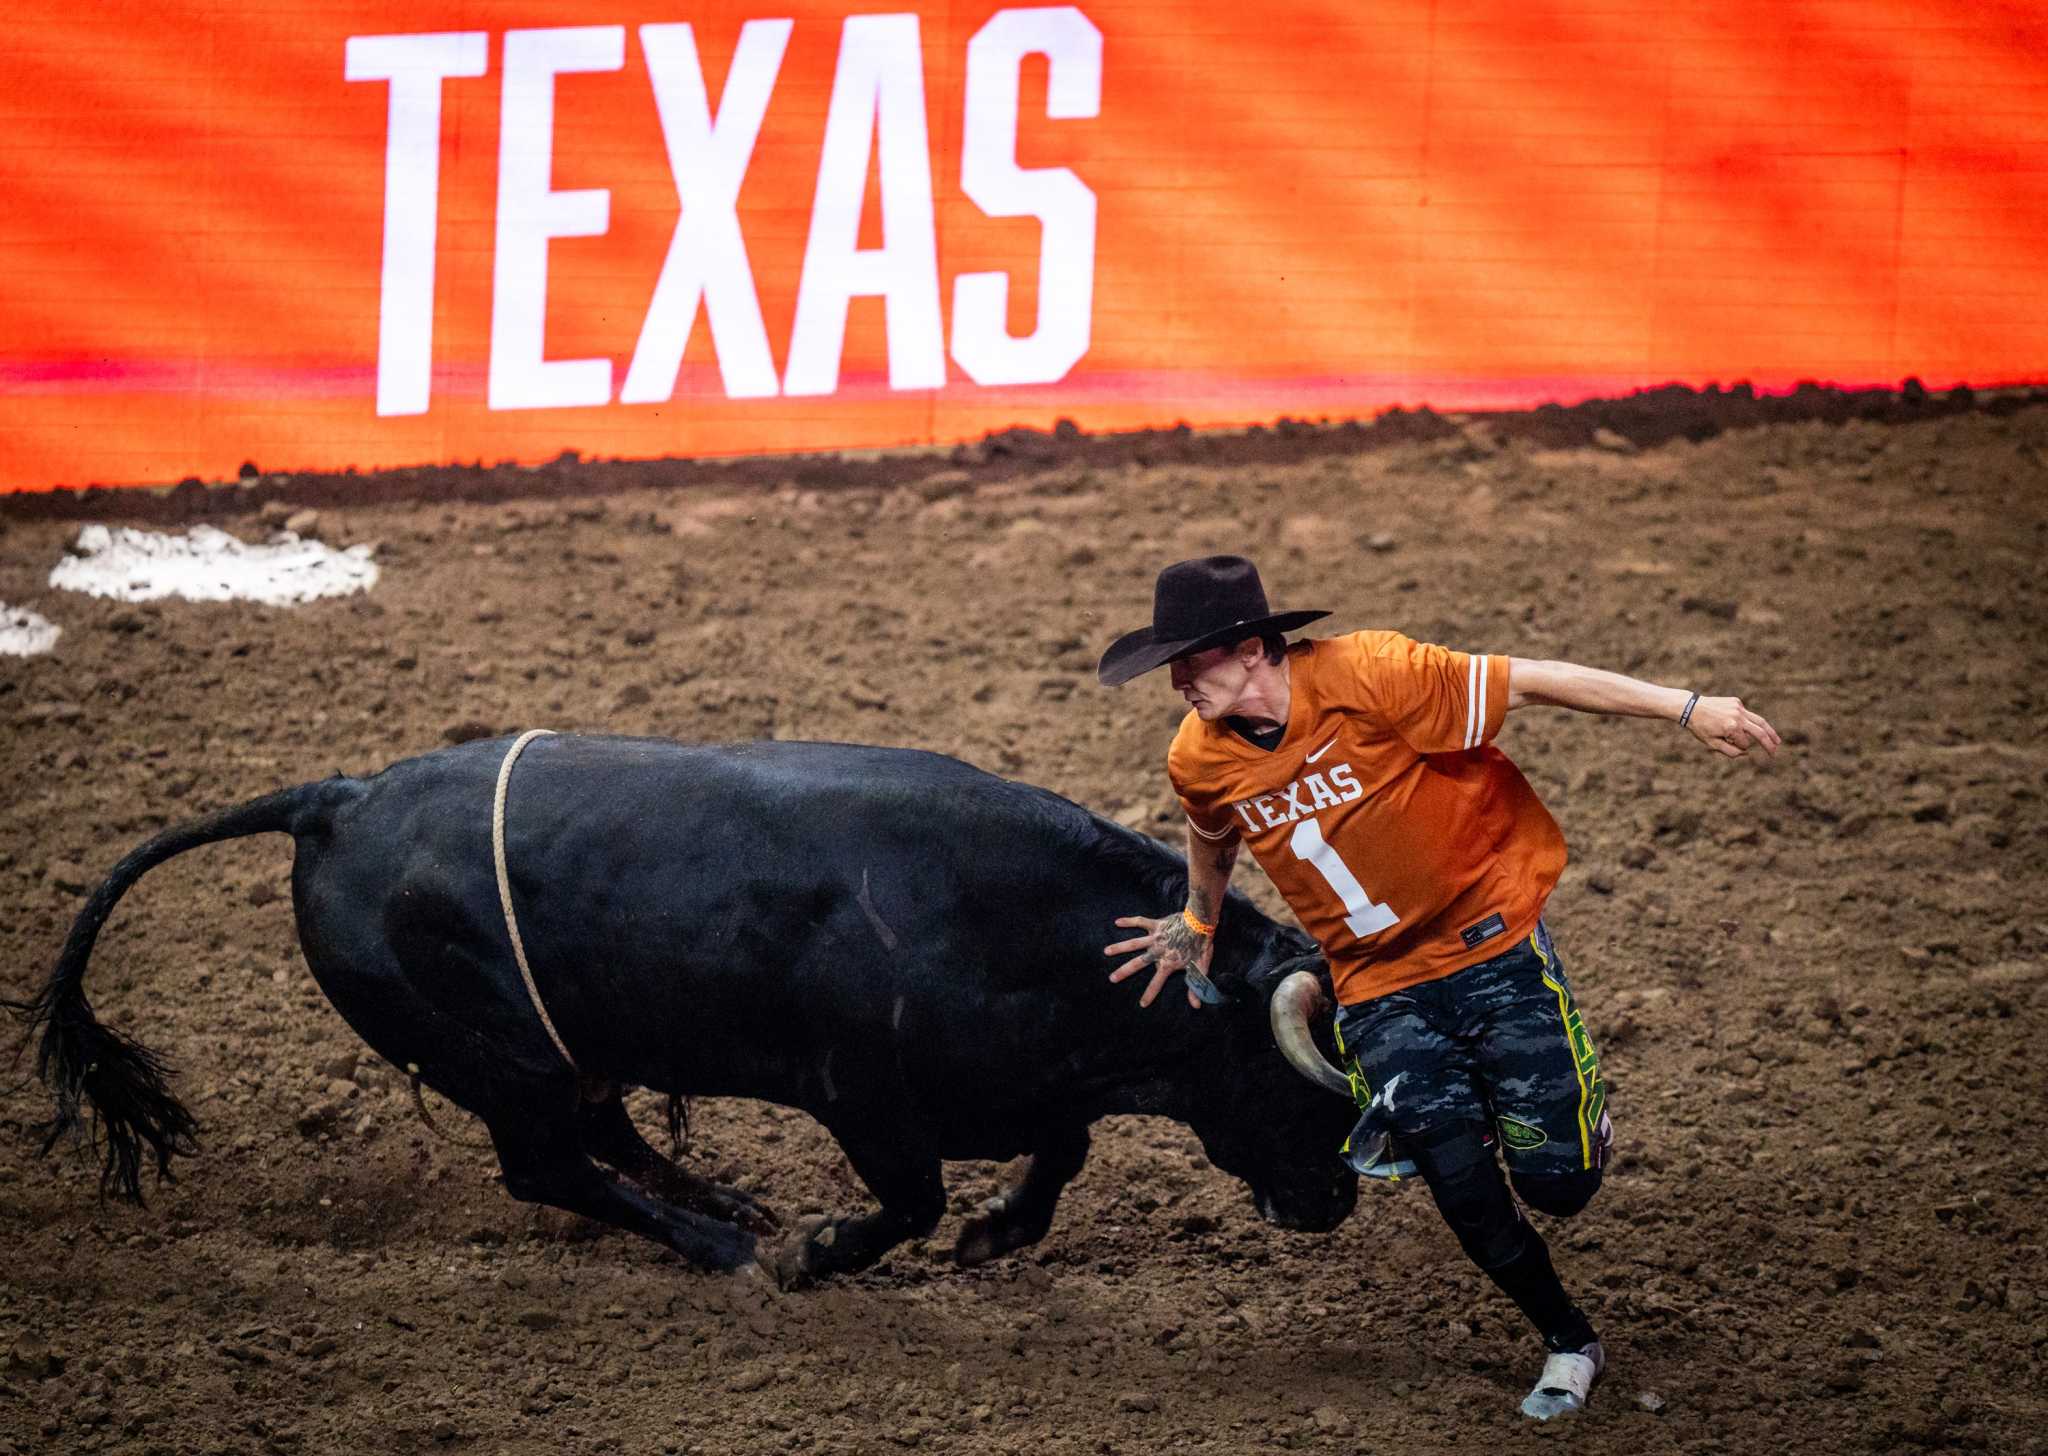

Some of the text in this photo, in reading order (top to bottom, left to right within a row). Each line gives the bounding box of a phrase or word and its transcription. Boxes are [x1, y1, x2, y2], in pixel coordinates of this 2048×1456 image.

[345, 6, 1103, 417] TEXAS
[1233, 763, 1364, 833] TEXAS
[1290, 817, 1401, 939] 1
